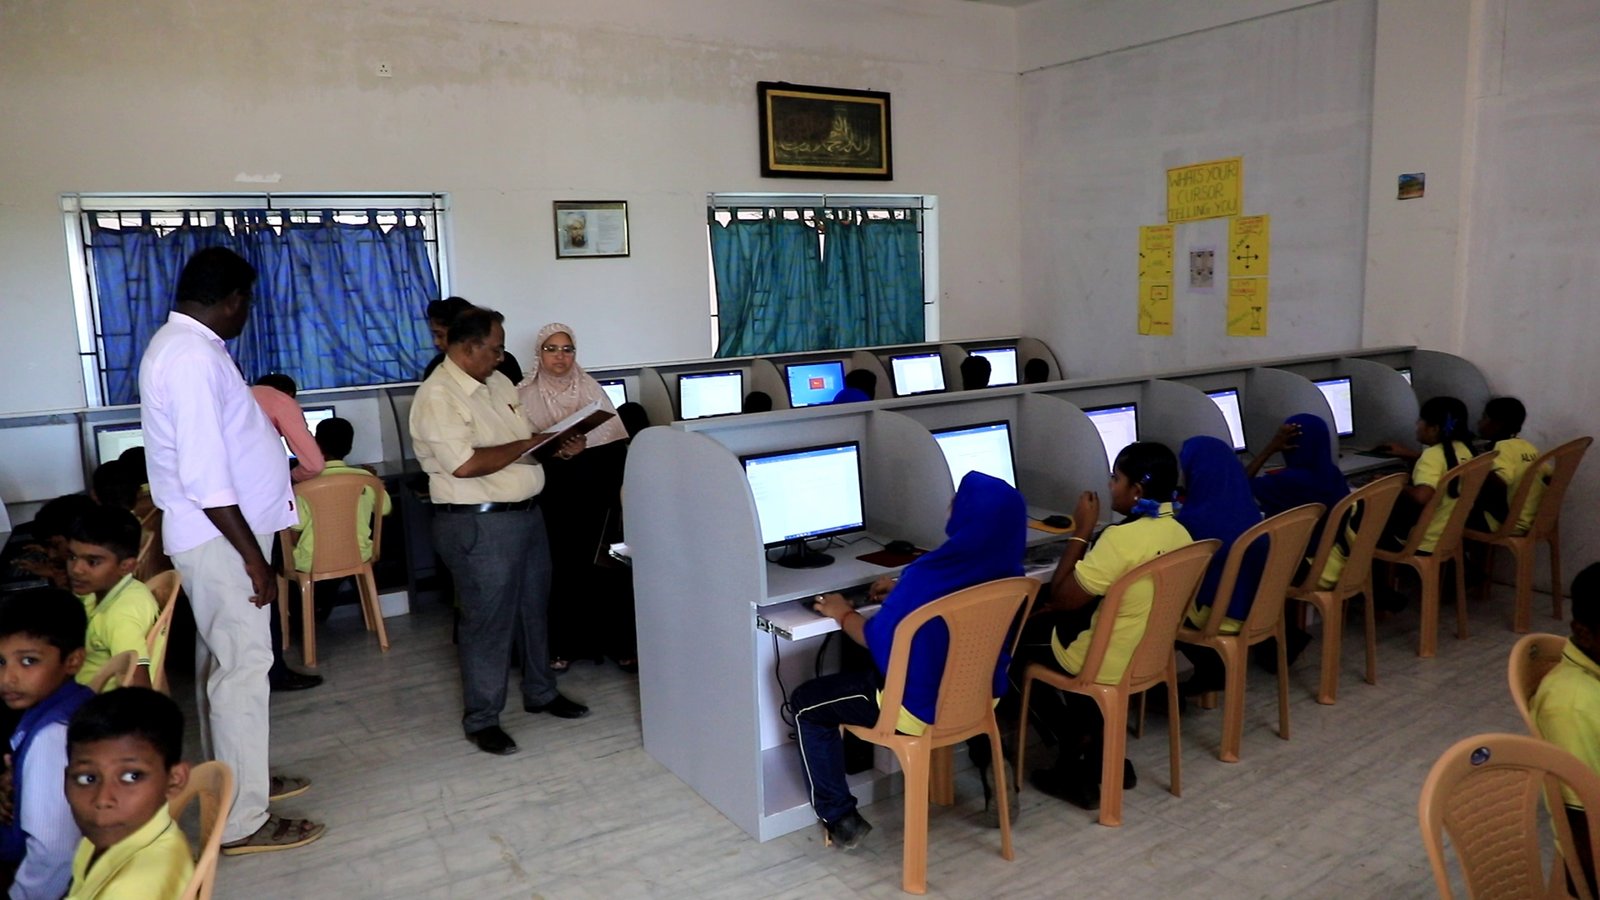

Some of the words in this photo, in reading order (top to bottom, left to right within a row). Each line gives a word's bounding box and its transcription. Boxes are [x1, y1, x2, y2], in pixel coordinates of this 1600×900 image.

[1204, 164, 1236, 183] YOUR
[1177, 182, 1224, 204] CURSOR
[1215, 199, 1236, 214] YOU
